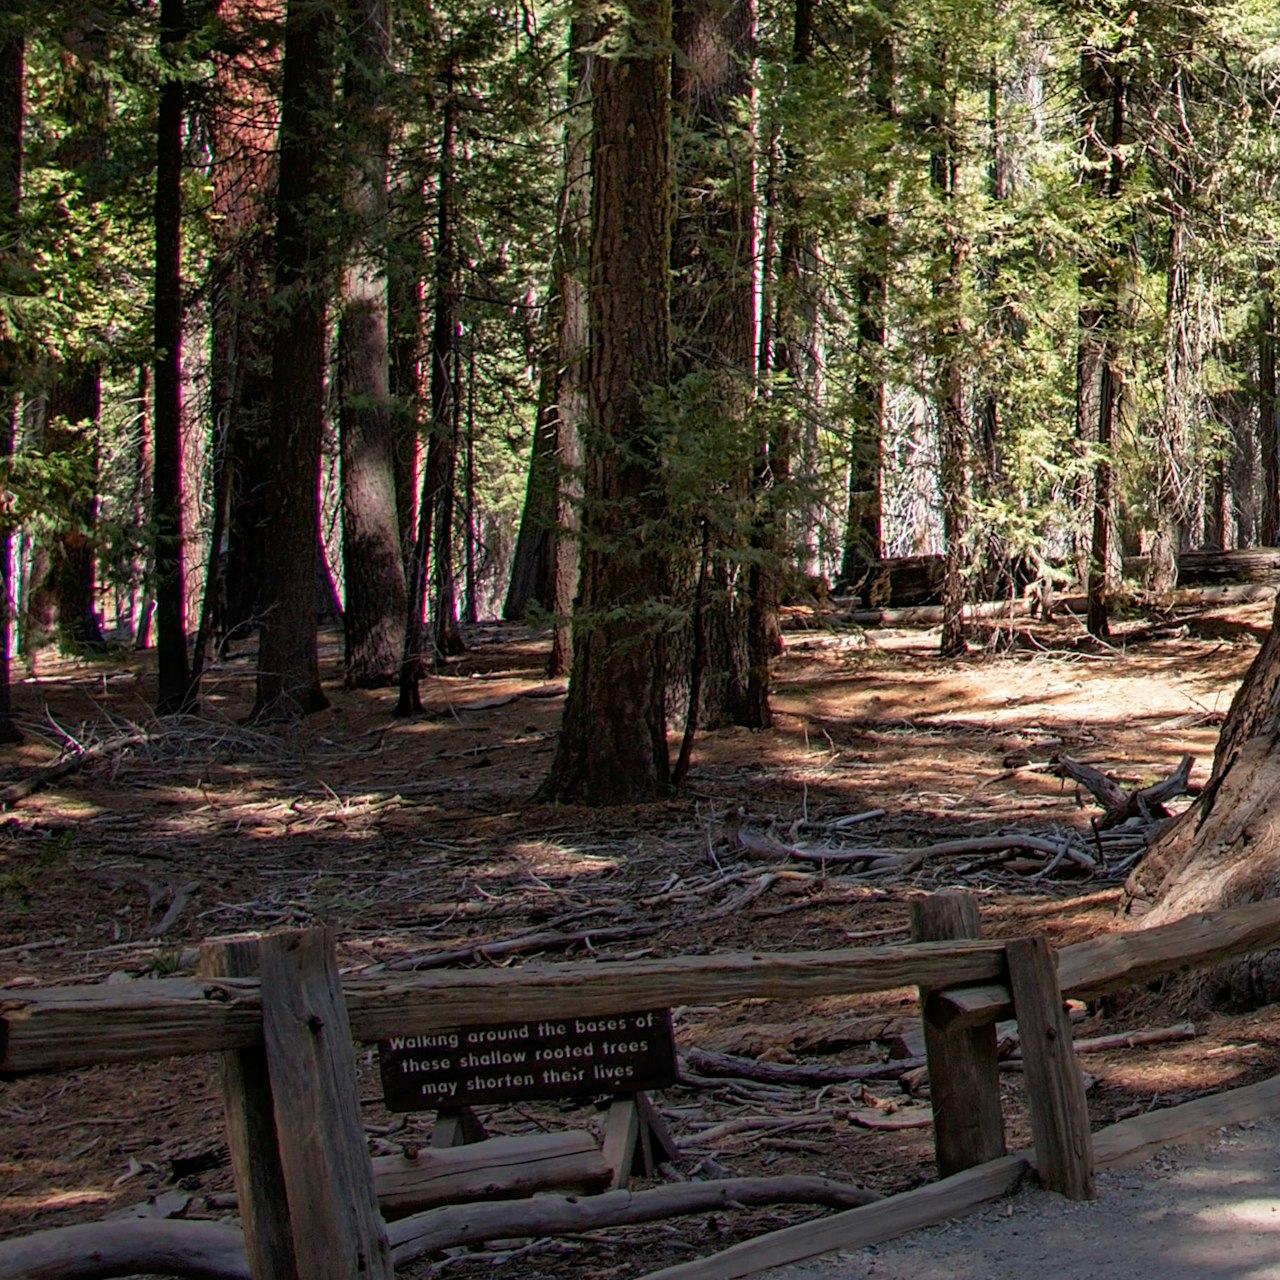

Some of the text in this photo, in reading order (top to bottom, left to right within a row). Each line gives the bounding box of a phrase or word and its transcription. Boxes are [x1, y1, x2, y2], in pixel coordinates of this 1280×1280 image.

[389, 1012, 654, 1050] Walking around the bases of
[402, 1040, 649, 1073] these shallow rooted trees
[421, 1063, 634, 1096] may shorten their lives
